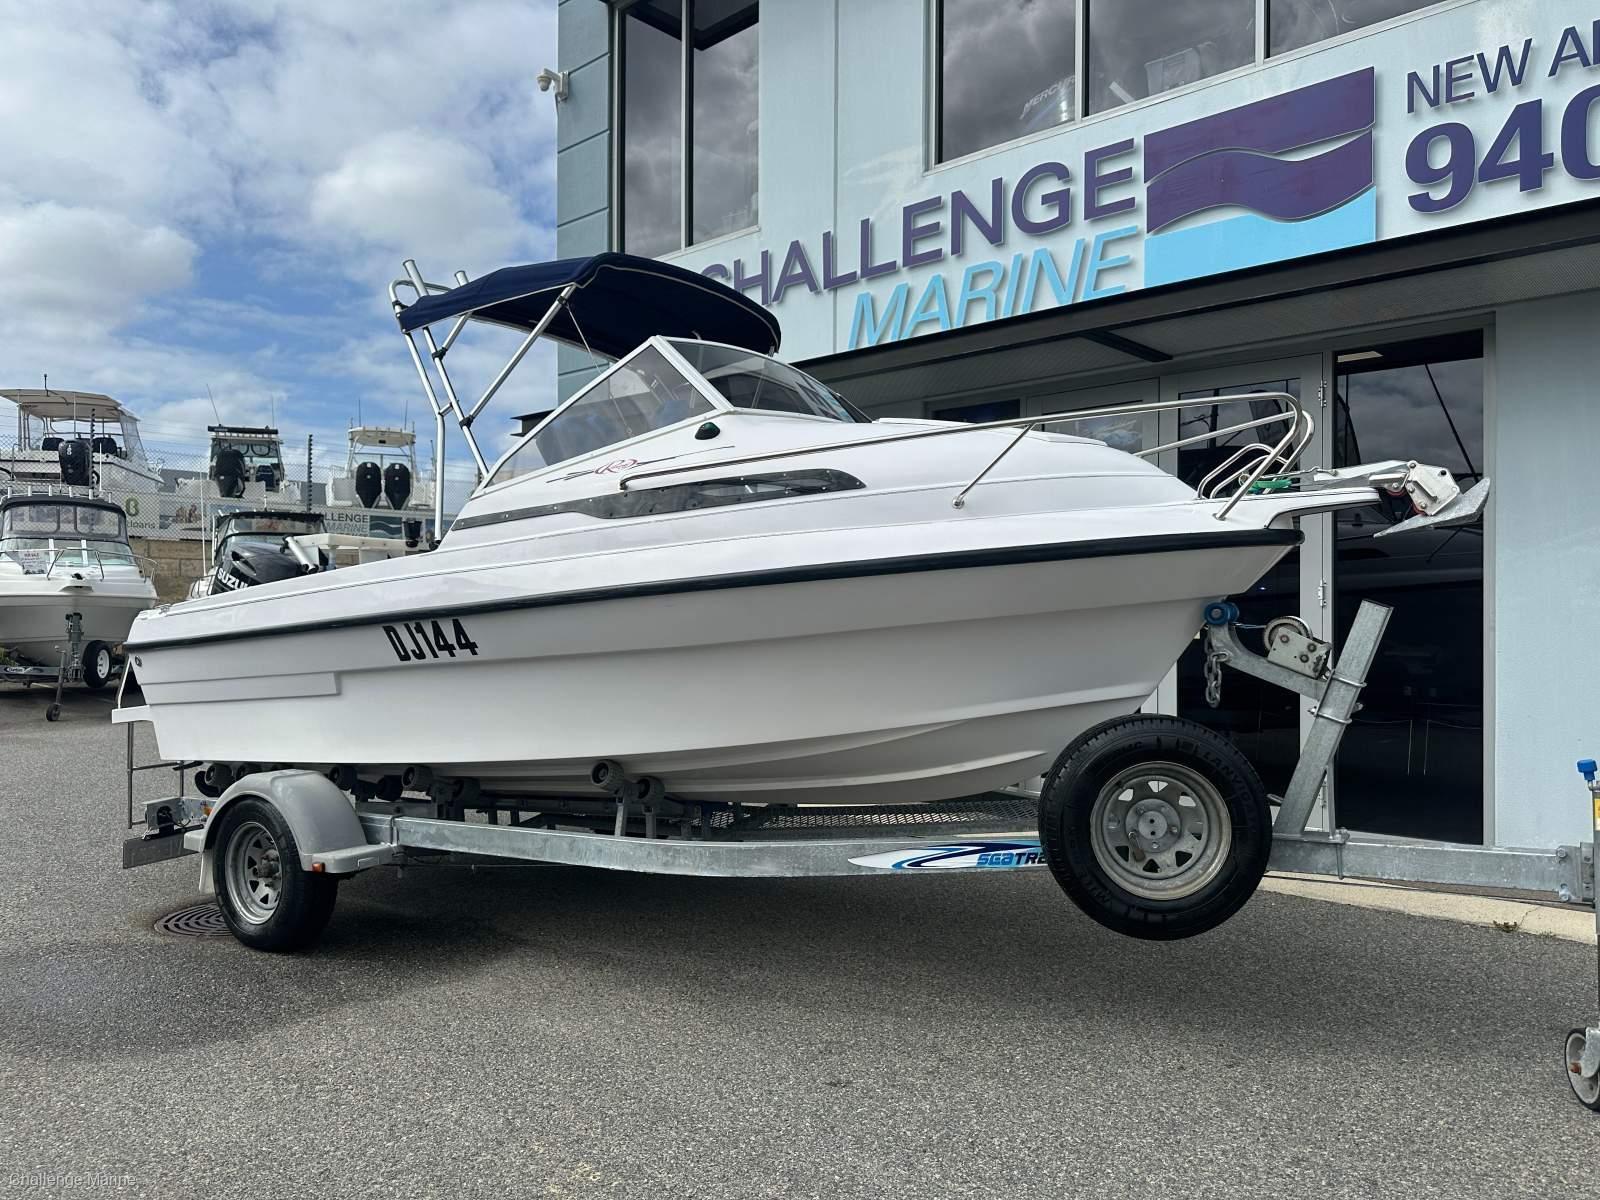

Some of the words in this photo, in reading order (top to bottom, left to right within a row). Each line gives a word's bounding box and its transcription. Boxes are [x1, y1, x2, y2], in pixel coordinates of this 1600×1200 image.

[1407, 38, 1533, 114] NEW
[1547, 20, 1600, 78] A
[1019, 74, 1076, 120] MERCUR
[847, 224, 1138, 350] MARINE
[323, 512, 369, 524] LLENGE
[382, 618, 479, 662] DJ144
